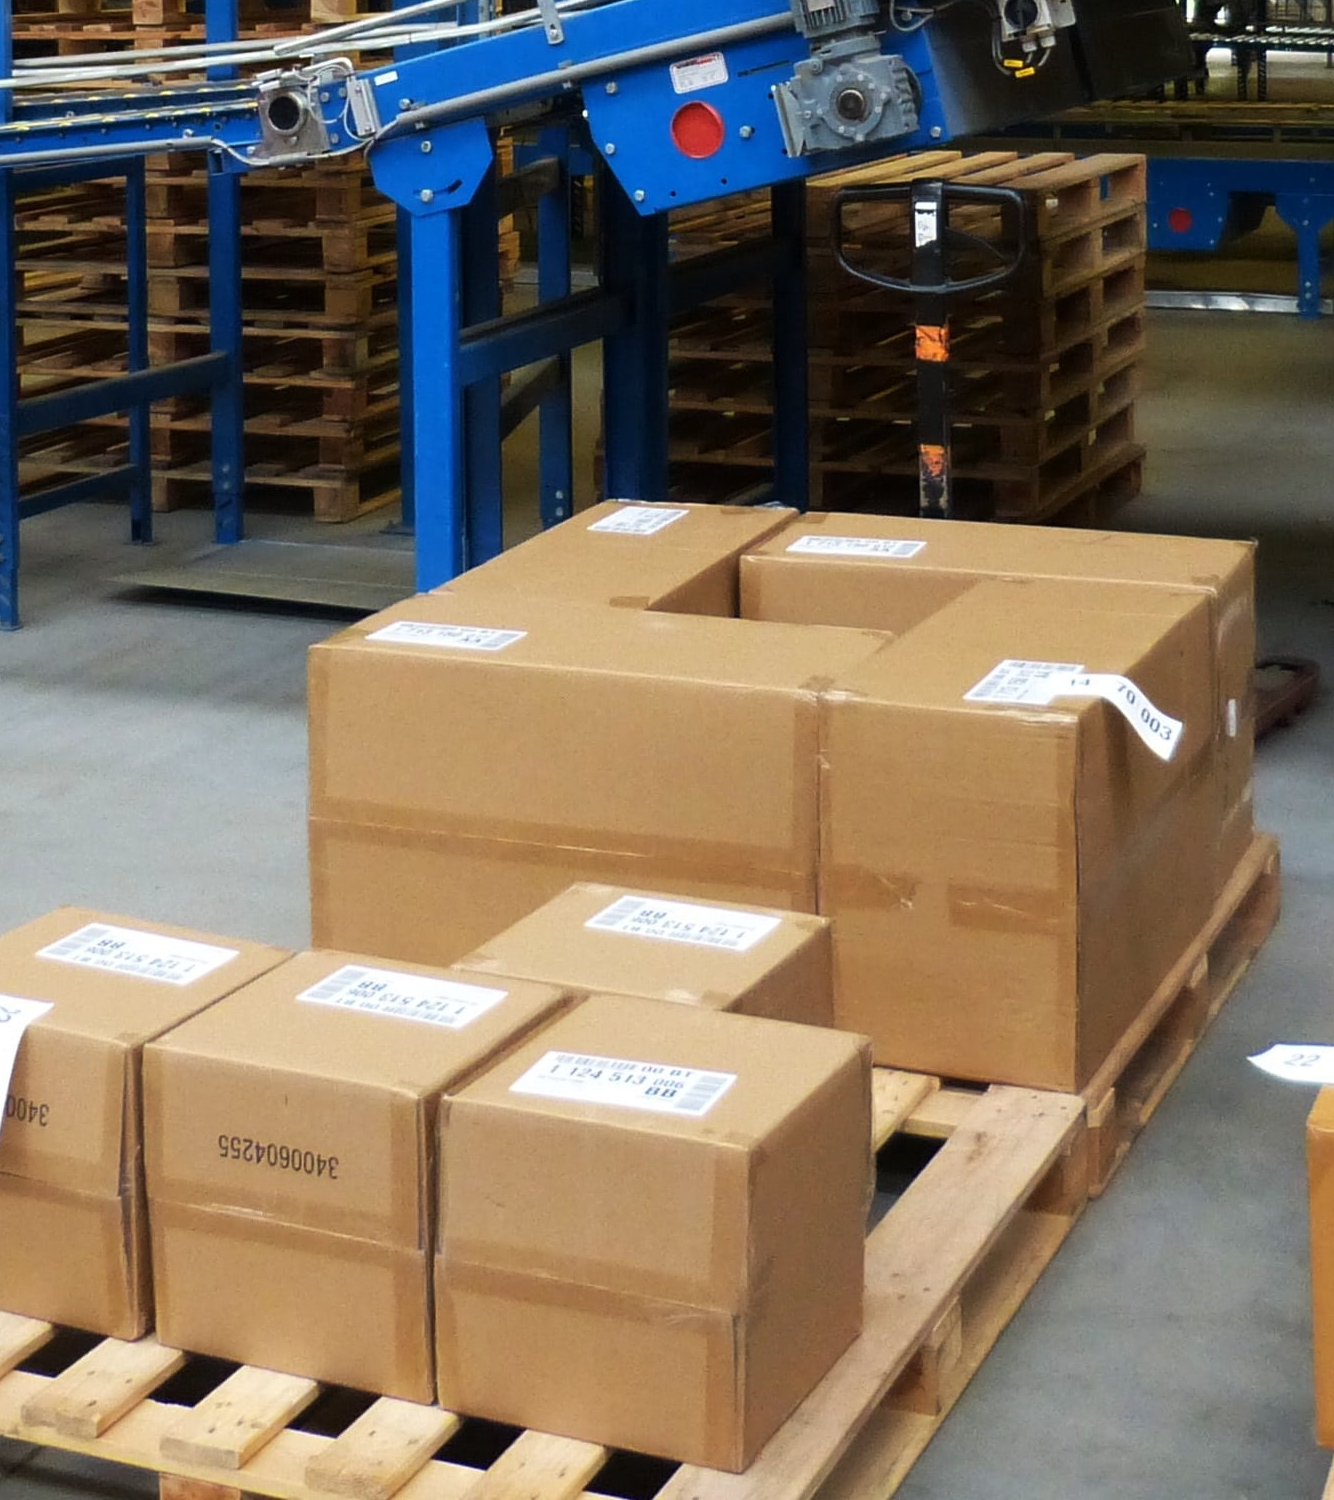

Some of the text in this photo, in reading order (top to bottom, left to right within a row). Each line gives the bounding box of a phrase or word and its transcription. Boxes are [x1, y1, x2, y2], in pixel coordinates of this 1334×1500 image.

[1117, 682, 1136, 704] 70
[1140, 707, 1173, 741] 003
[569, 1067, 604, 1080] 124
[608, 1071, 648, 1086] 513
[1283, 1053, 1321, 1068] 22
[218, 1134, 339, 1180] 3400604255
